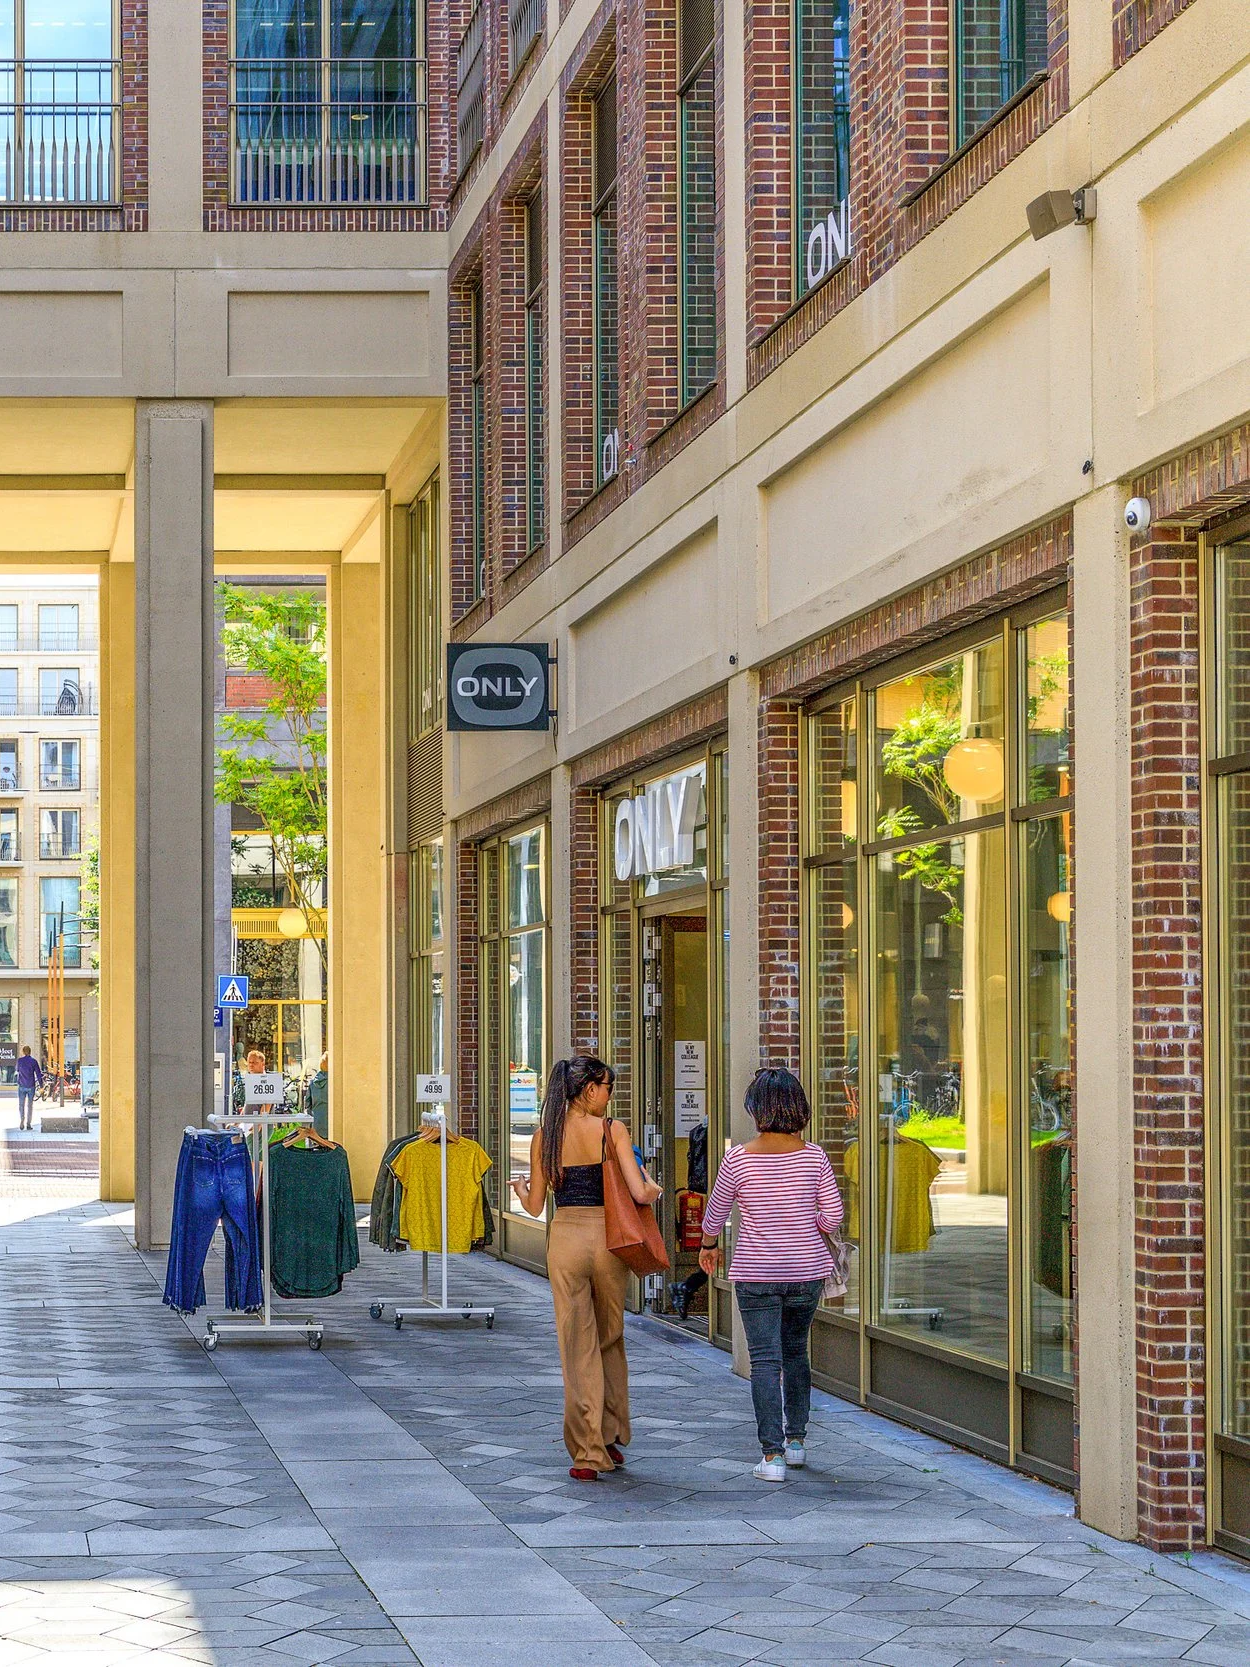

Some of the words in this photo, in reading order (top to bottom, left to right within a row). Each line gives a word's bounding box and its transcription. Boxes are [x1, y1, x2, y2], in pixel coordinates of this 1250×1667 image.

[457, 676, 539, 697] ONLY
[615, 776, 702, 881] ONLY
[253, 1084, 275, 1095] 26.99
[424, 1084, 443, 1094] 49.99
